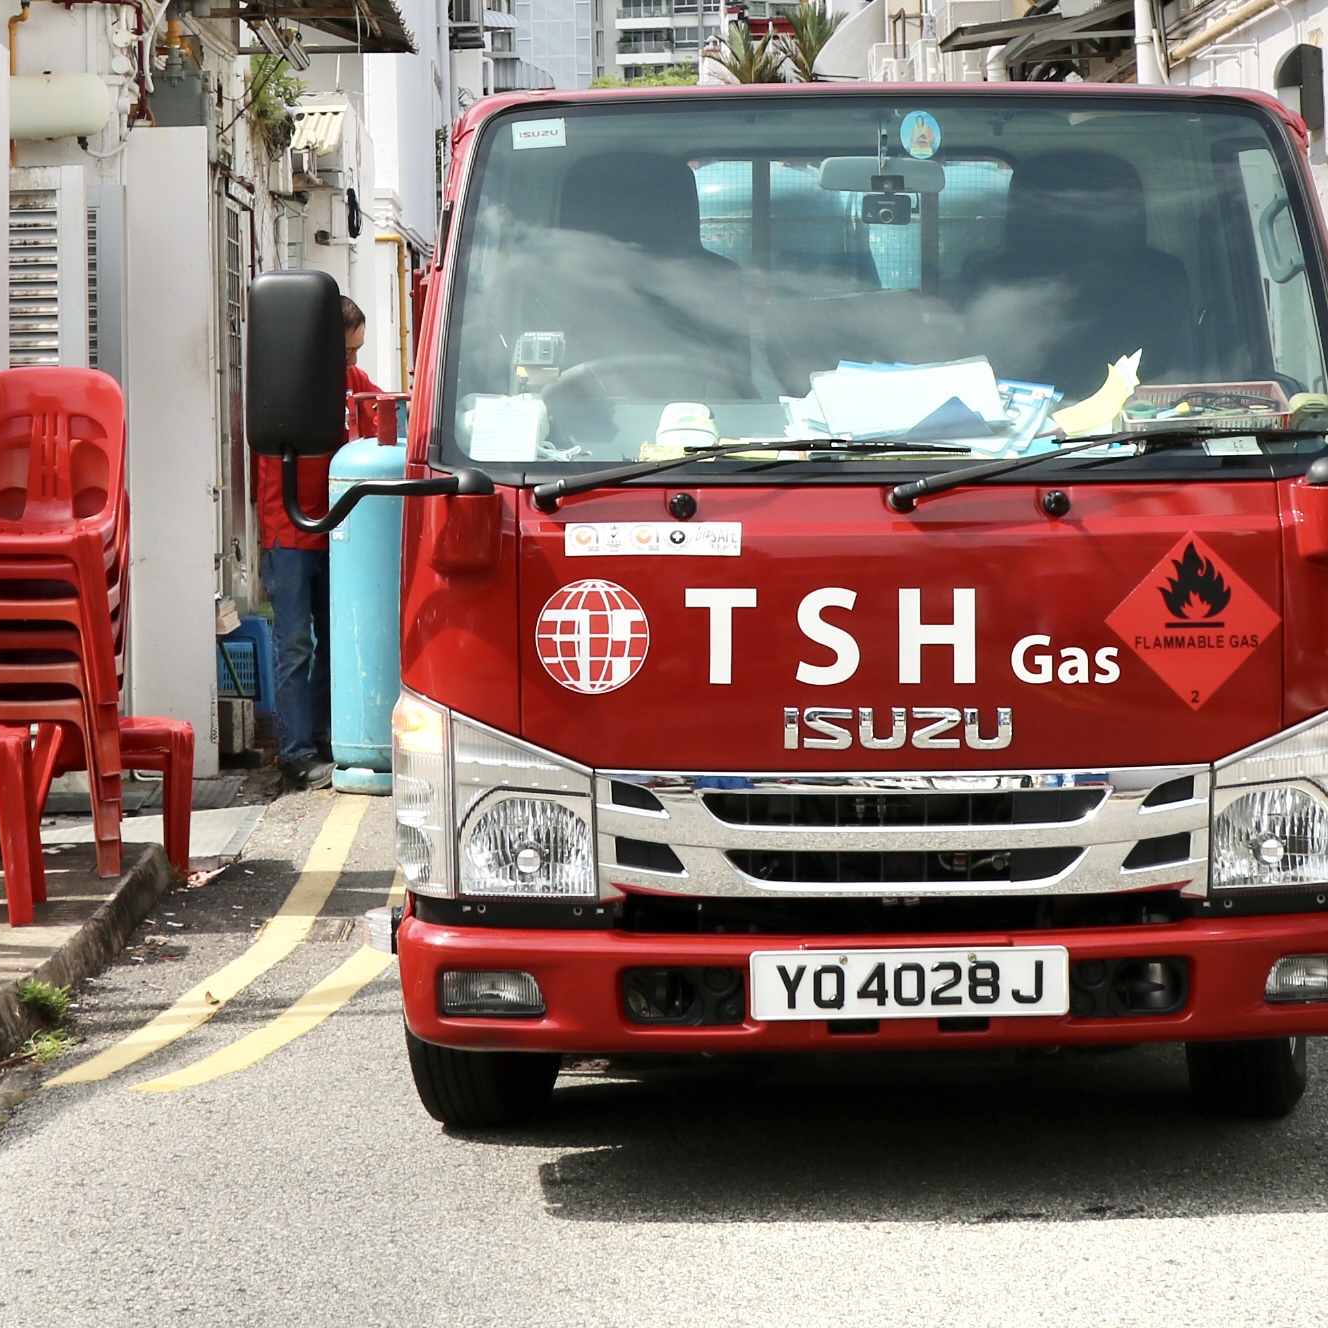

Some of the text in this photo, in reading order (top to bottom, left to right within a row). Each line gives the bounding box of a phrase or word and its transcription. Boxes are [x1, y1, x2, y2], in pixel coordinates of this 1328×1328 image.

[519, 129, 558, 139] ISUZU
[1135, 634, 1259, 649] FLAMMABLE GAS
[1010, 634, 1121, 685] Gas
[1190, 690, 1200, 703] 2
[783, 706, 1013, 750] ISUZU
